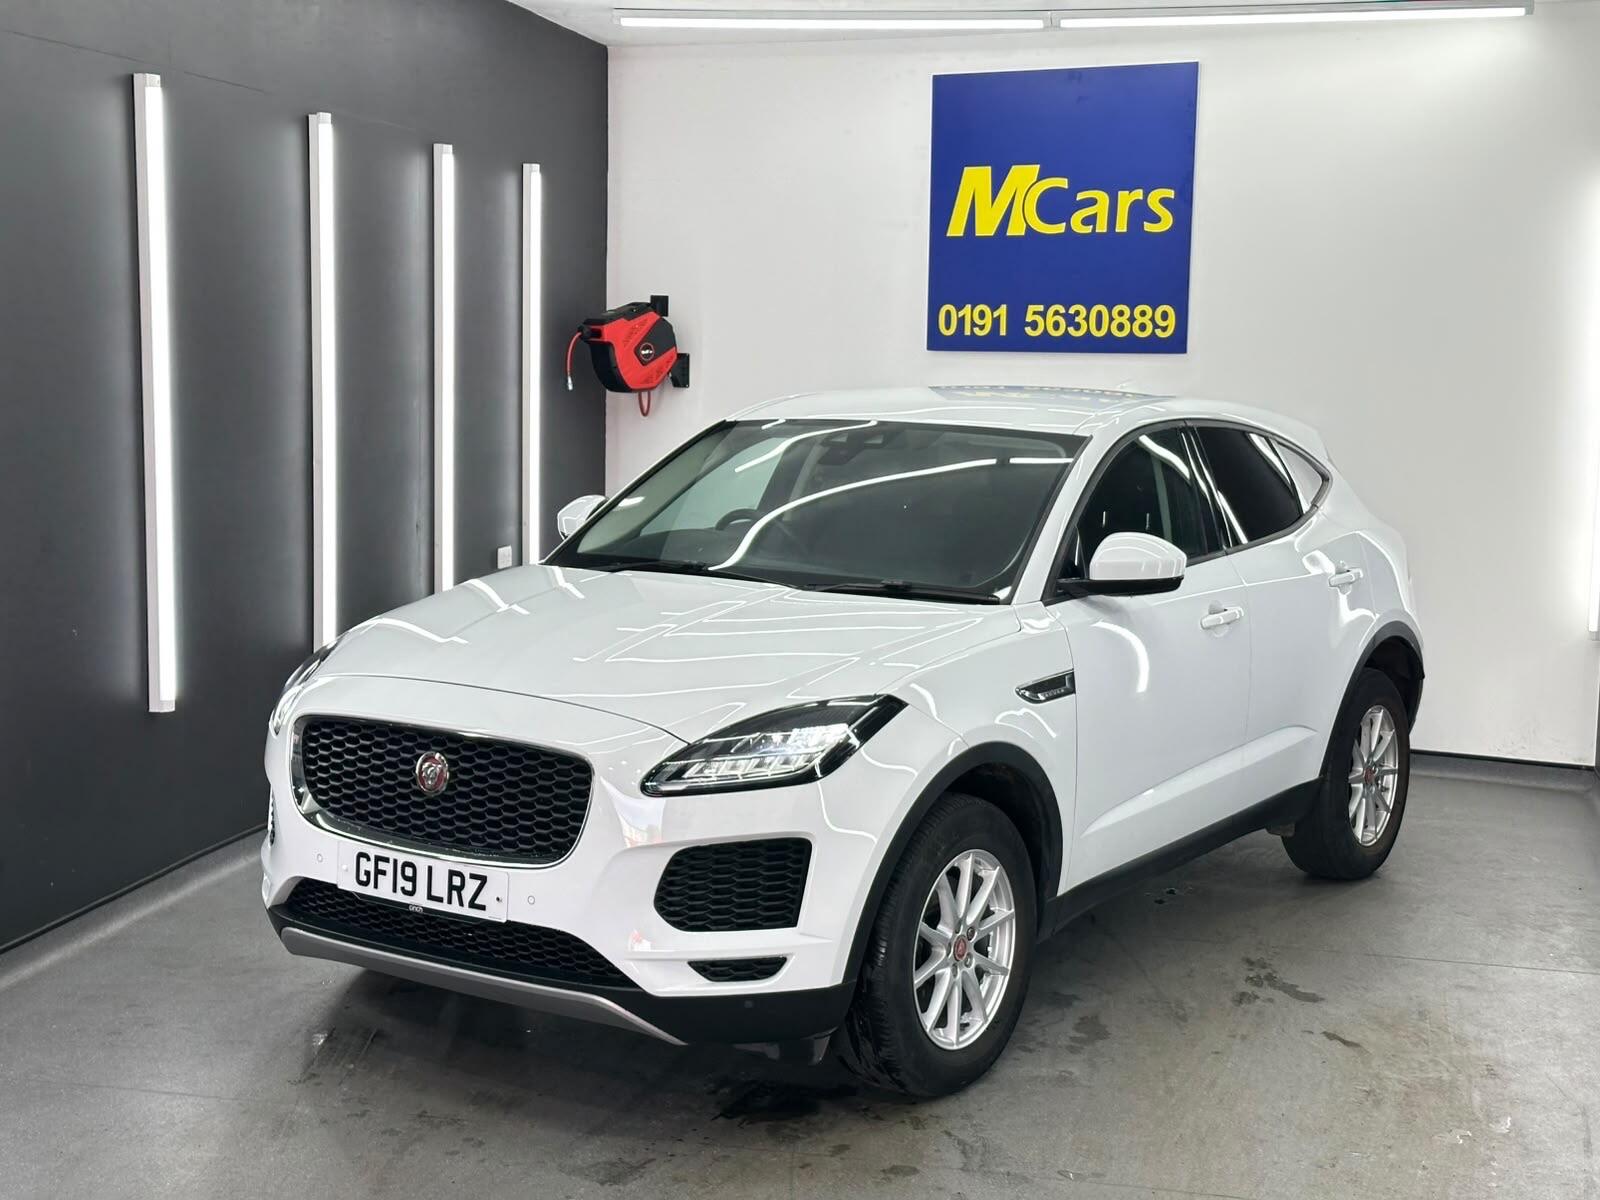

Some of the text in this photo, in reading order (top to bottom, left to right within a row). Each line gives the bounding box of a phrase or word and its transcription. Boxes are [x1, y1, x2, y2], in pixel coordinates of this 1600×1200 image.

[937, 304, 1177, 338] 0191 5630889
[355, 851, 488, 911] GF19 LRZ
